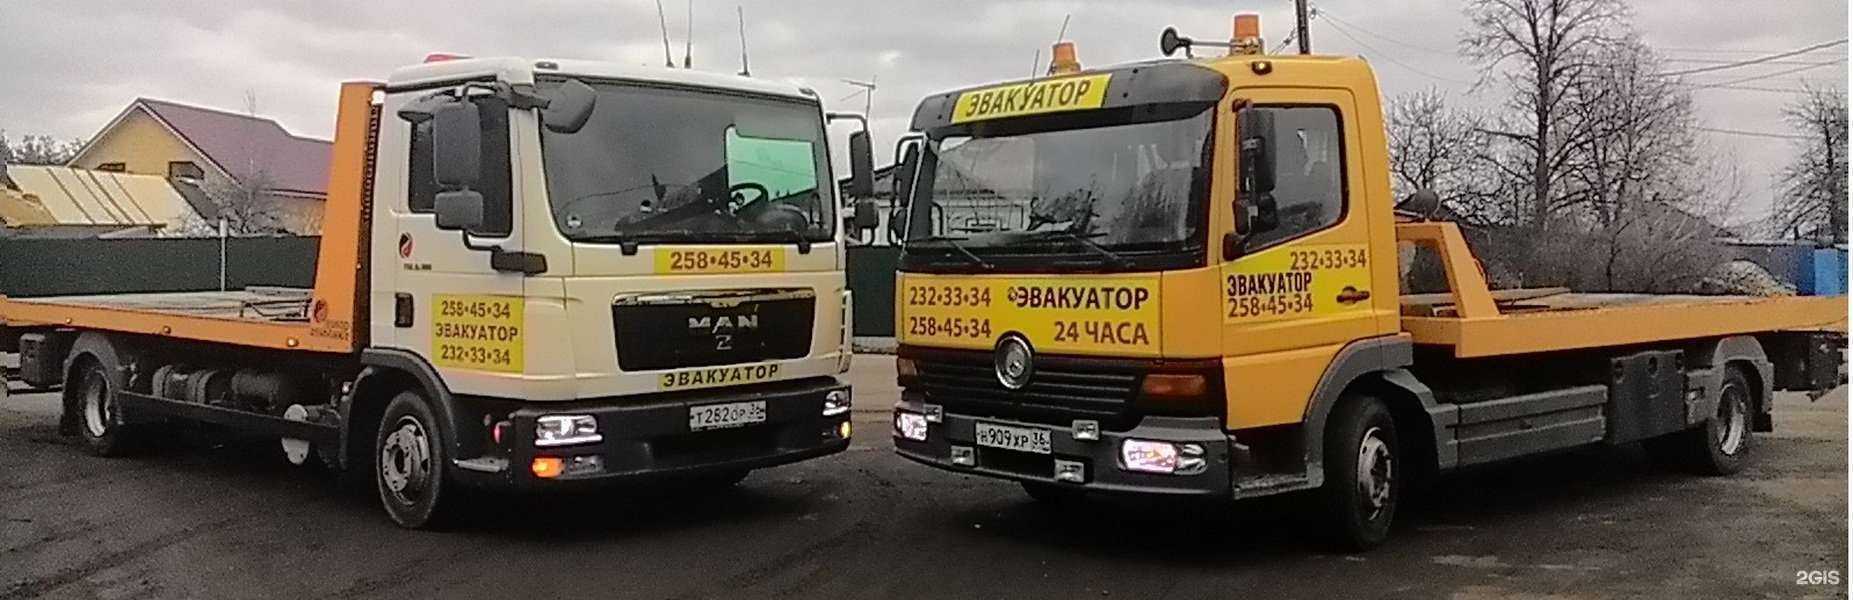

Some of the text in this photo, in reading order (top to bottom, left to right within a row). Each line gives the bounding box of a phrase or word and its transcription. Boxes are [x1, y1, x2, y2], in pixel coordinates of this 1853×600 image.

[966, 80, 1091, 117] ЭВАКУАТОР
[1227, 272, 1312, 296] ЭВАКУАТОР
[1017, 286, 1149, 310] ЭВАКУАТОР
[435, 322, 519, 343] ЭВАКУАТОР
[688, 315, 760, 333] MAN
[1054, 320, 1150, 345] 24 ЧАСА
[663, 363, 779, 388] ЭВАКУАТОР
